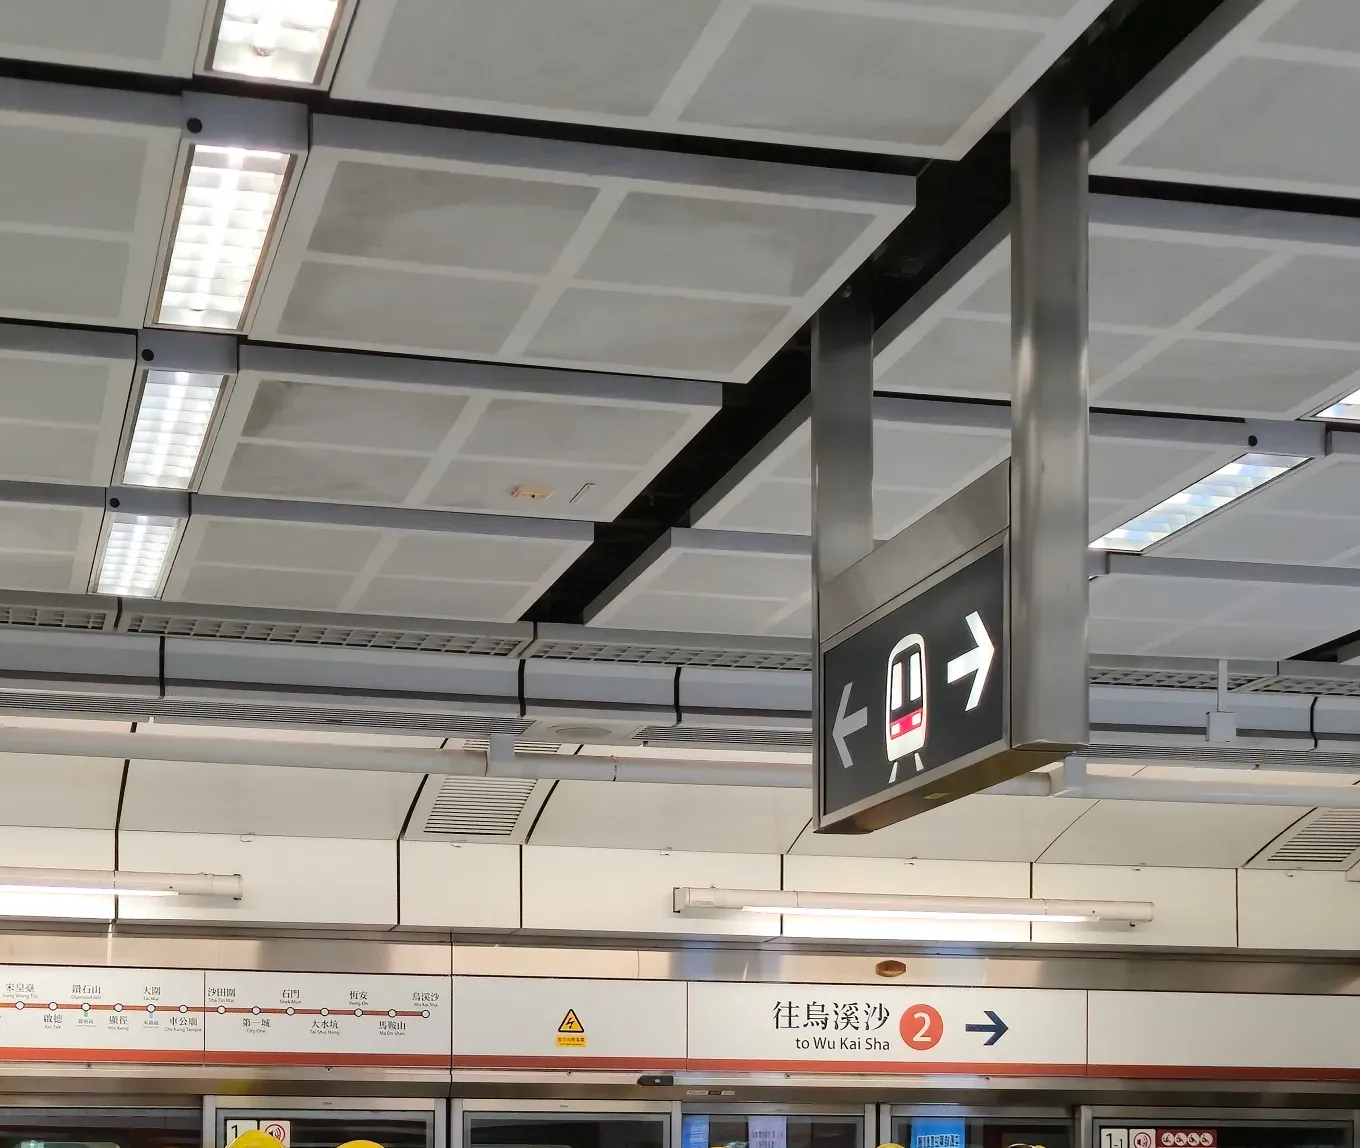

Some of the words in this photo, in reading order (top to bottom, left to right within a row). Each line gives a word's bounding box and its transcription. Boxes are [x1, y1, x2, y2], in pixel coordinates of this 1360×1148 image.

[772, 1001, 890, 1031] 往烏溪沙
[912, 1011, 932, 1042] 2
[796, 1037, 810, 1050] to
[813, 1037, 836, 1050] Wu
[840, 1037, 861, 1050] Kai
[865, 1037, 890, 1050] Sha
